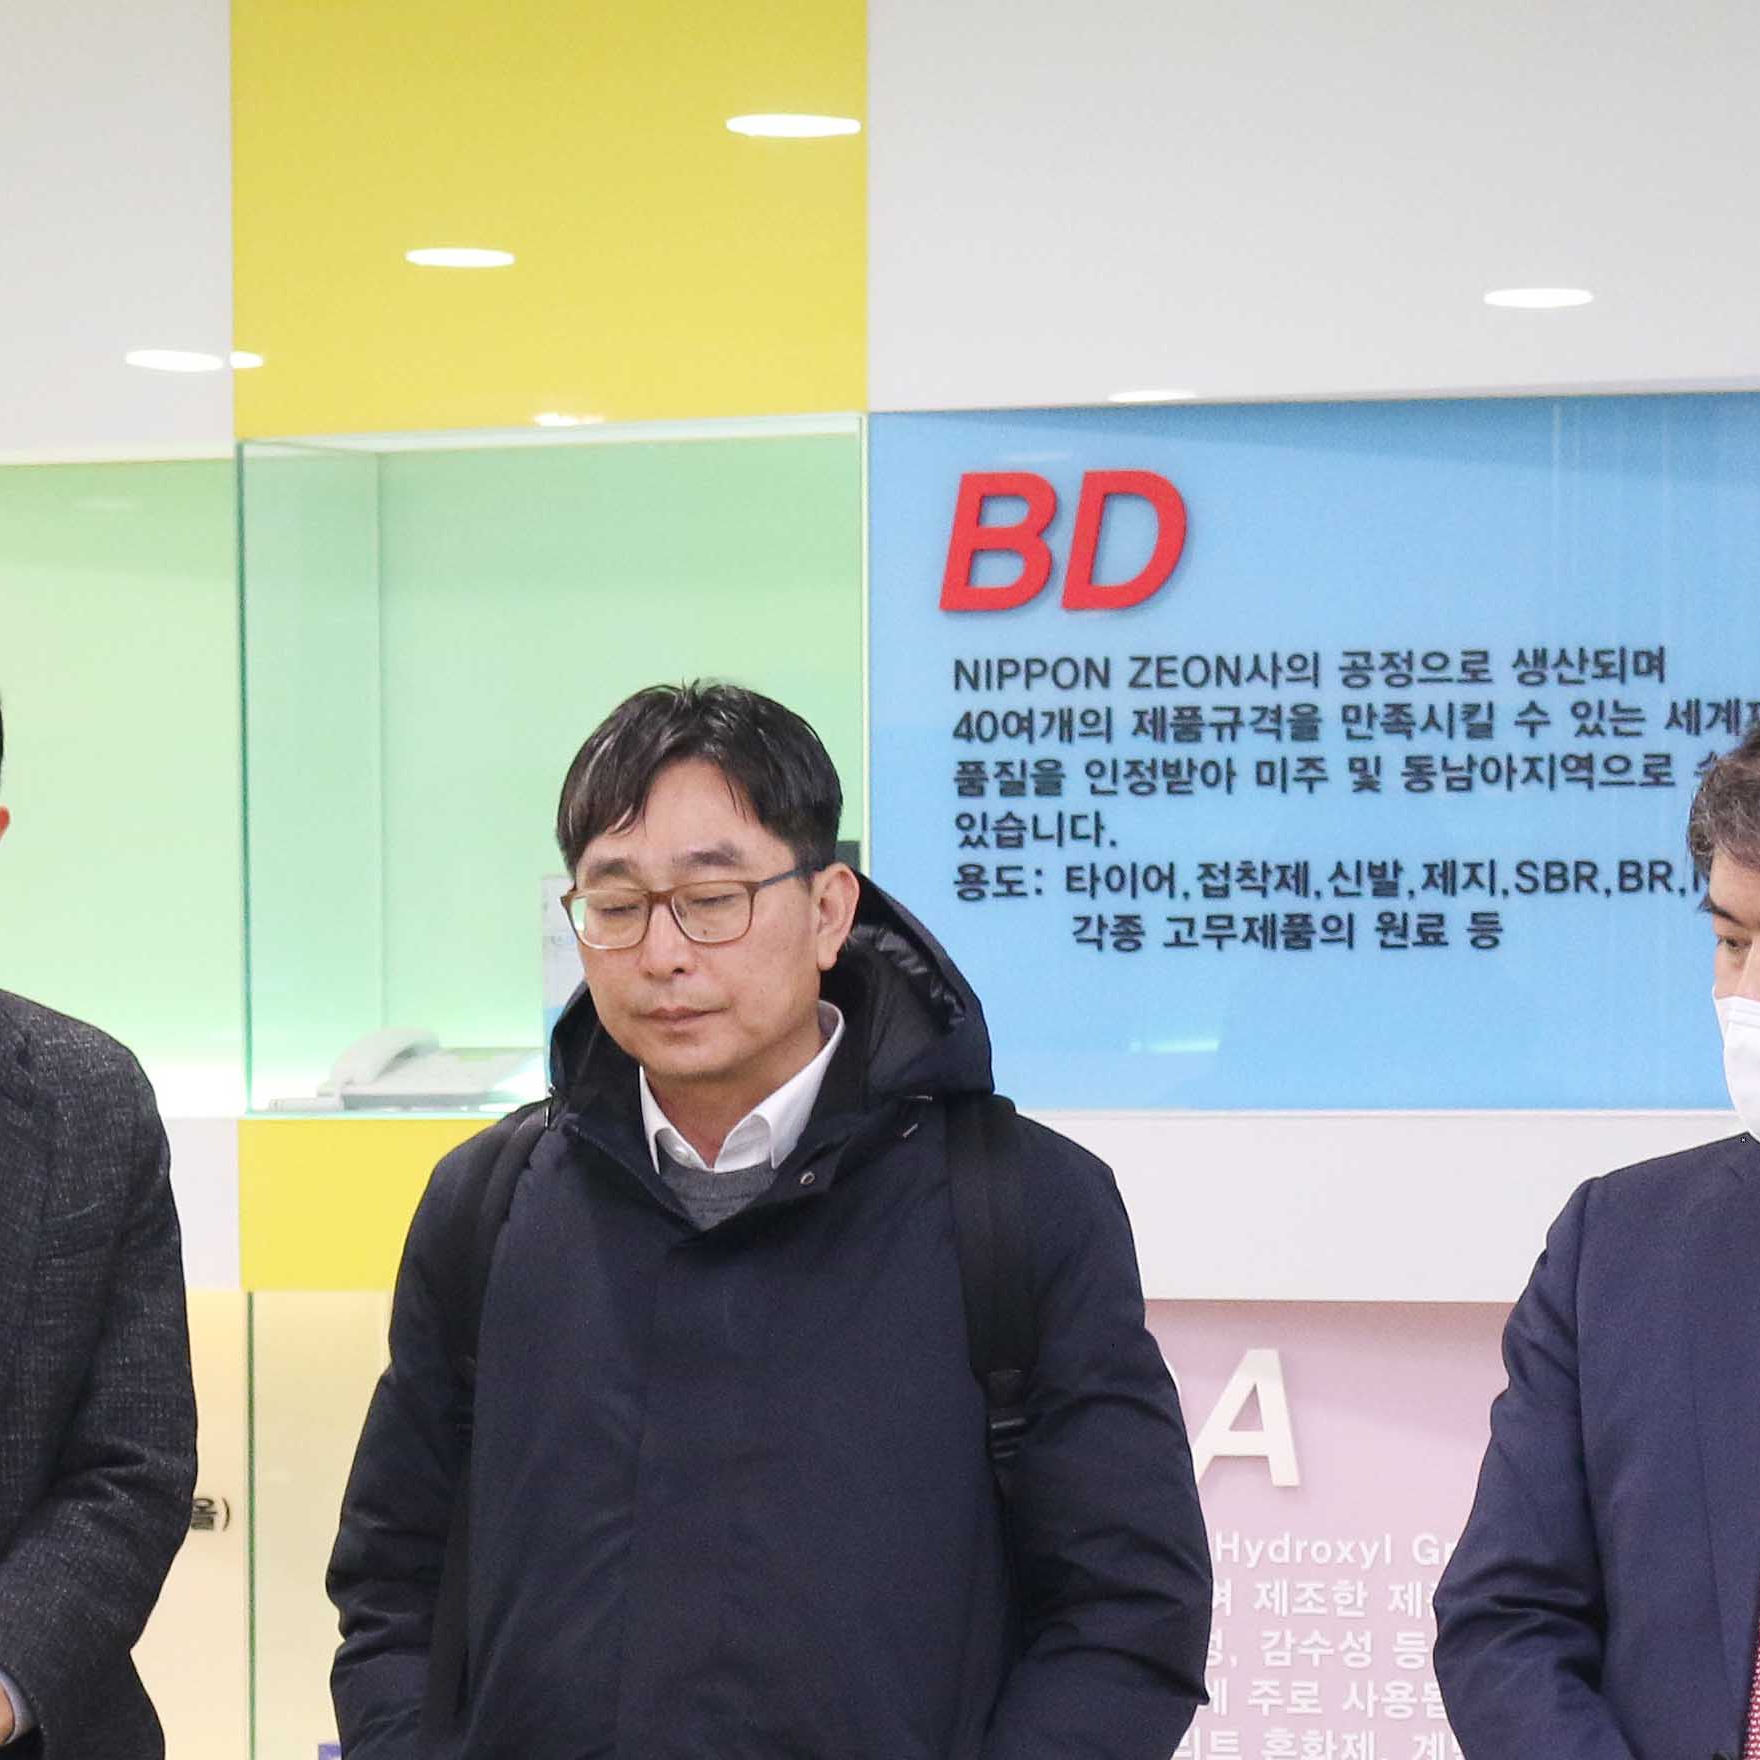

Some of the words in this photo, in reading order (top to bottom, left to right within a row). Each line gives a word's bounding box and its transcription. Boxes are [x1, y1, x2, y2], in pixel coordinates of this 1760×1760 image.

[939, 469, 1189, 613] BD
[952, 656, 1112, 693] NIPPON
[1127, 650, 1321, 690] ZEON사의
[1337, 648, 1494, 688] 공정으로
[1511, 645, 1667, 686] 생산되며
[951, 706, 1114, 746] 40여개의
[1131, 702, 1321, 744] 제품규격을
[1339, 700, 1495, 742] 만족시킬
[1513, 701, 1552, 741] 수
[1571, 699, 1647, 739] 있는
[952, 757, 1067, 800] 품질을
[1084, 756, 1238, 798] 인정받아
[1254, 754, 1331, 795] 미주
[1346, 753, 1385, 796] 및
[1400, 749, 1676, 793] 동남아지역으로
[952, 810, 1119, 852] 있습니다.
[952, 860, 1044, 903] 용도:
[1072, 912, 1147, 953] 각종
[1162, 911, 1357, 954] 고무제품의
[1374, 909, 1450, 952] 원료
[1466, 909, 1506, 951] 등
[1214, 1531, 1392, 1569] Hydroxyl
[1253, 1578, 1369, 1618] 제조한
[1261, 1628, 1374, 1669] 감수성
[1246, 1679, 1324, 1717] 주로
